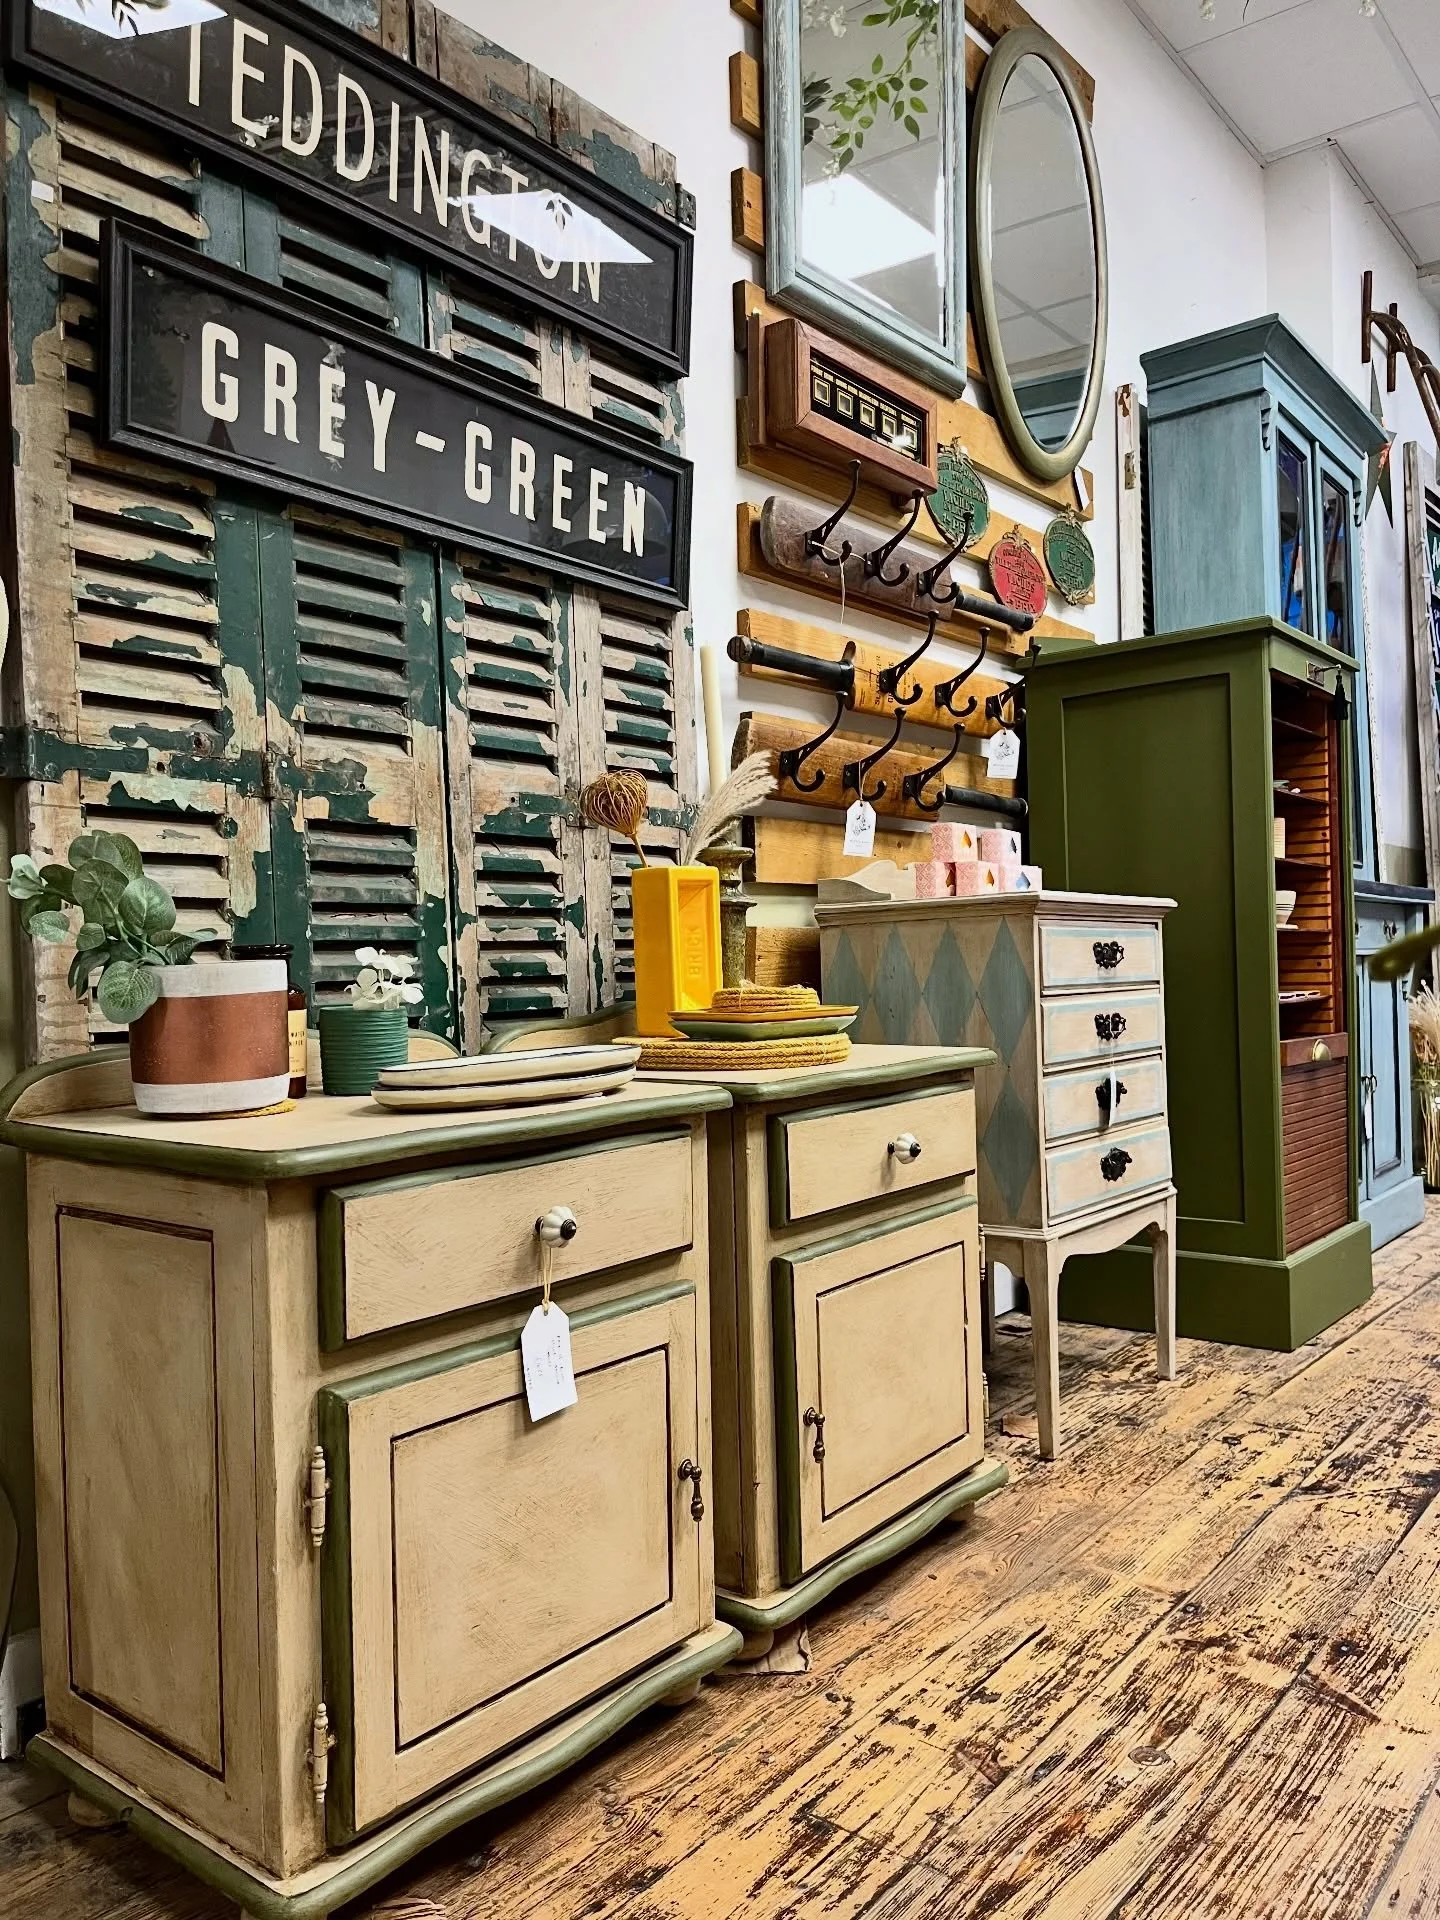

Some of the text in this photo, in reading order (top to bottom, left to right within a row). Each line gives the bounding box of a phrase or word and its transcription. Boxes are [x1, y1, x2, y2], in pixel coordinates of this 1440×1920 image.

[200, 320, 647, 558] GREY-GREEN
[952, 518, 976, 535] PRX
[686, 926, 702, 977] BRICK
